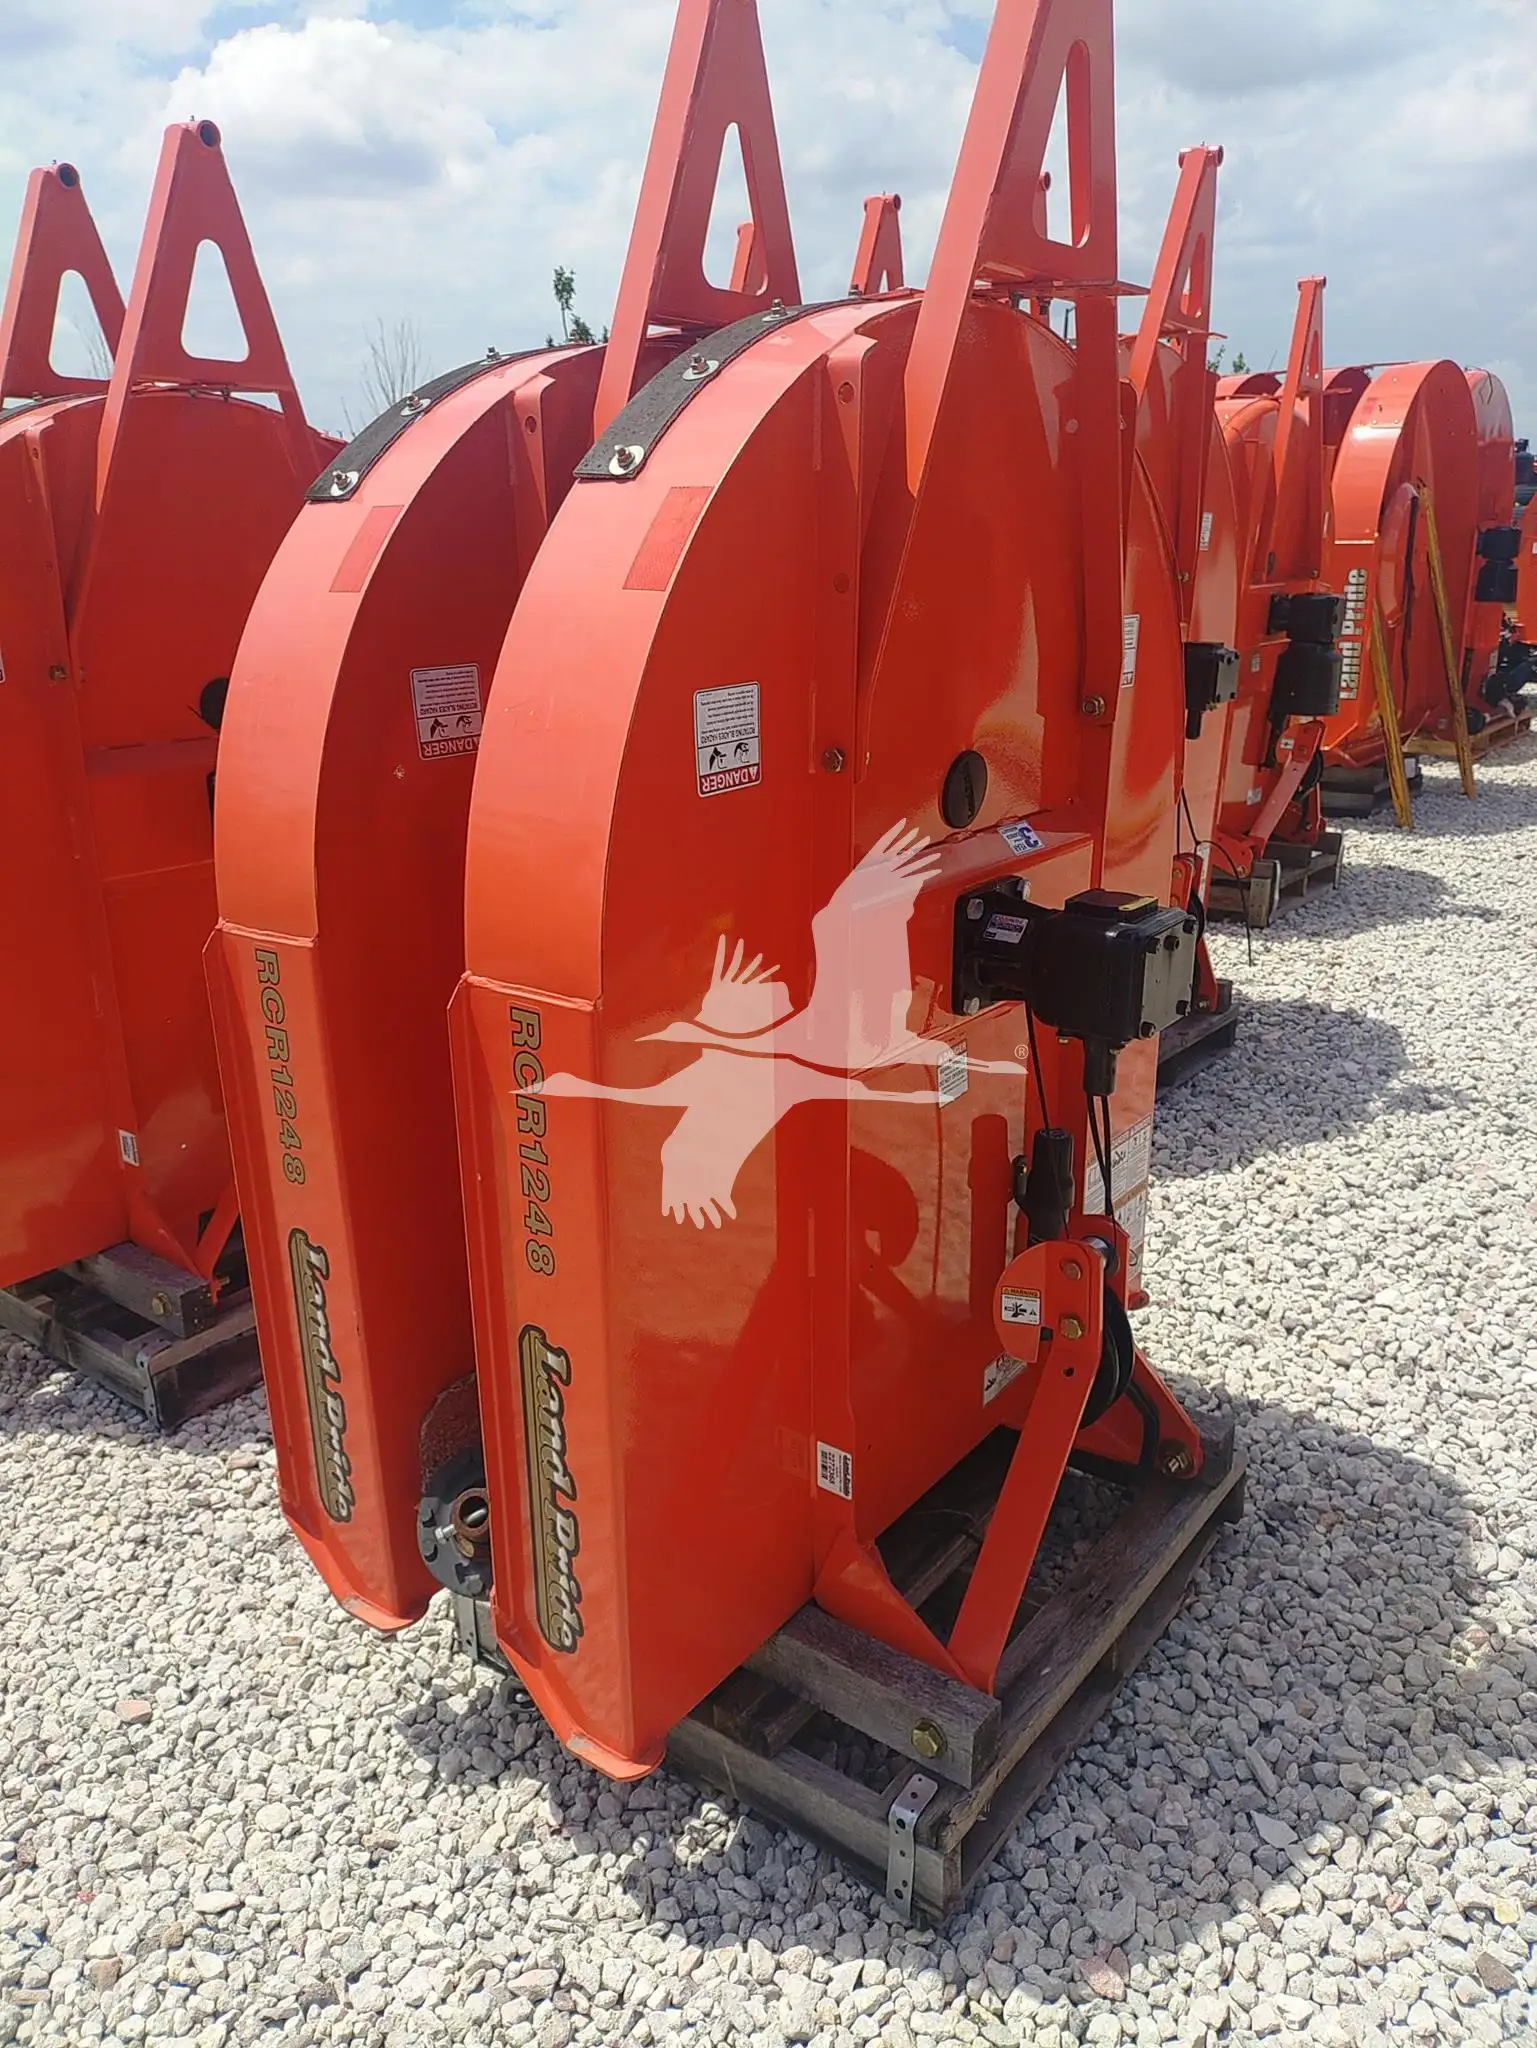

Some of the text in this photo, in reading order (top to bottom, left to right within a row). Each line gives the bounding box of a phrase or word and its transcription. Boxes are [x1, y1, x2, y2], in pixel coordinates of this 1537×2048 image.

[700, 727, 756, 744] ROTATING BLADES HAZARD
[1338, 641, 1362, 700] Land
[422, 737, 473, 757] DANGER
[701, 769, 749, 793] DANGER
[255, 948, 306, 1185] RCR1248
[510, 1005, 555, 1277] RCR1248
[300, 1237, 355, 1523] Land Pride
[535, 1338, 583, 1650] Land Pride
